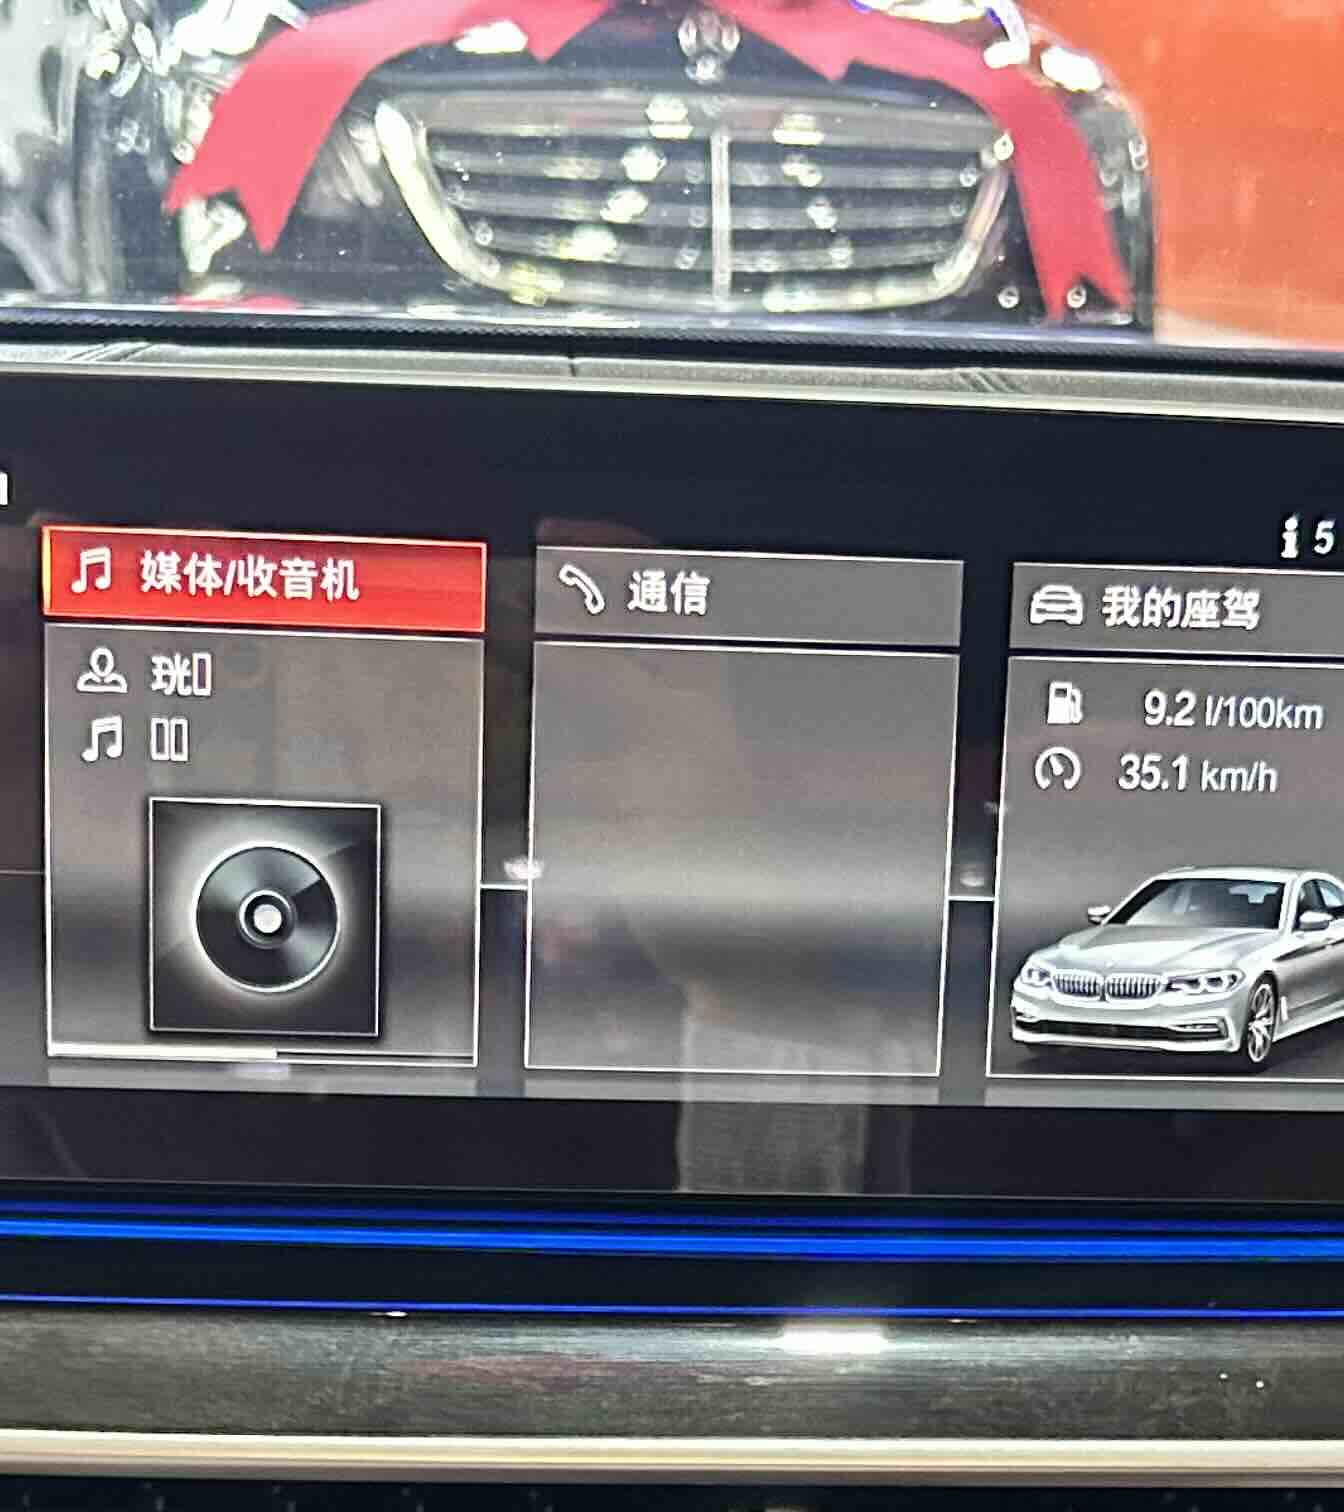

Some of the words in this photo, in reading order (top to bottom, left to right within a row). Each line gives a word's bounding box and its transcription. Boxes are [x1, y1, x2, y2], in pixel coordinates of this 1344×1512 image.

[1313, 519, 1336, 555] 5
[140, 549, 361, 602] 媒体/收音机
[626, 571, 710, 617] 通信
[1101, 584, 1261, 631] 我的座驾
[1143, 688, 1197, 728] 9.2
[1118, 751, 1189, 792] 35.1
[1201, 759, 1279, 793] km/h
